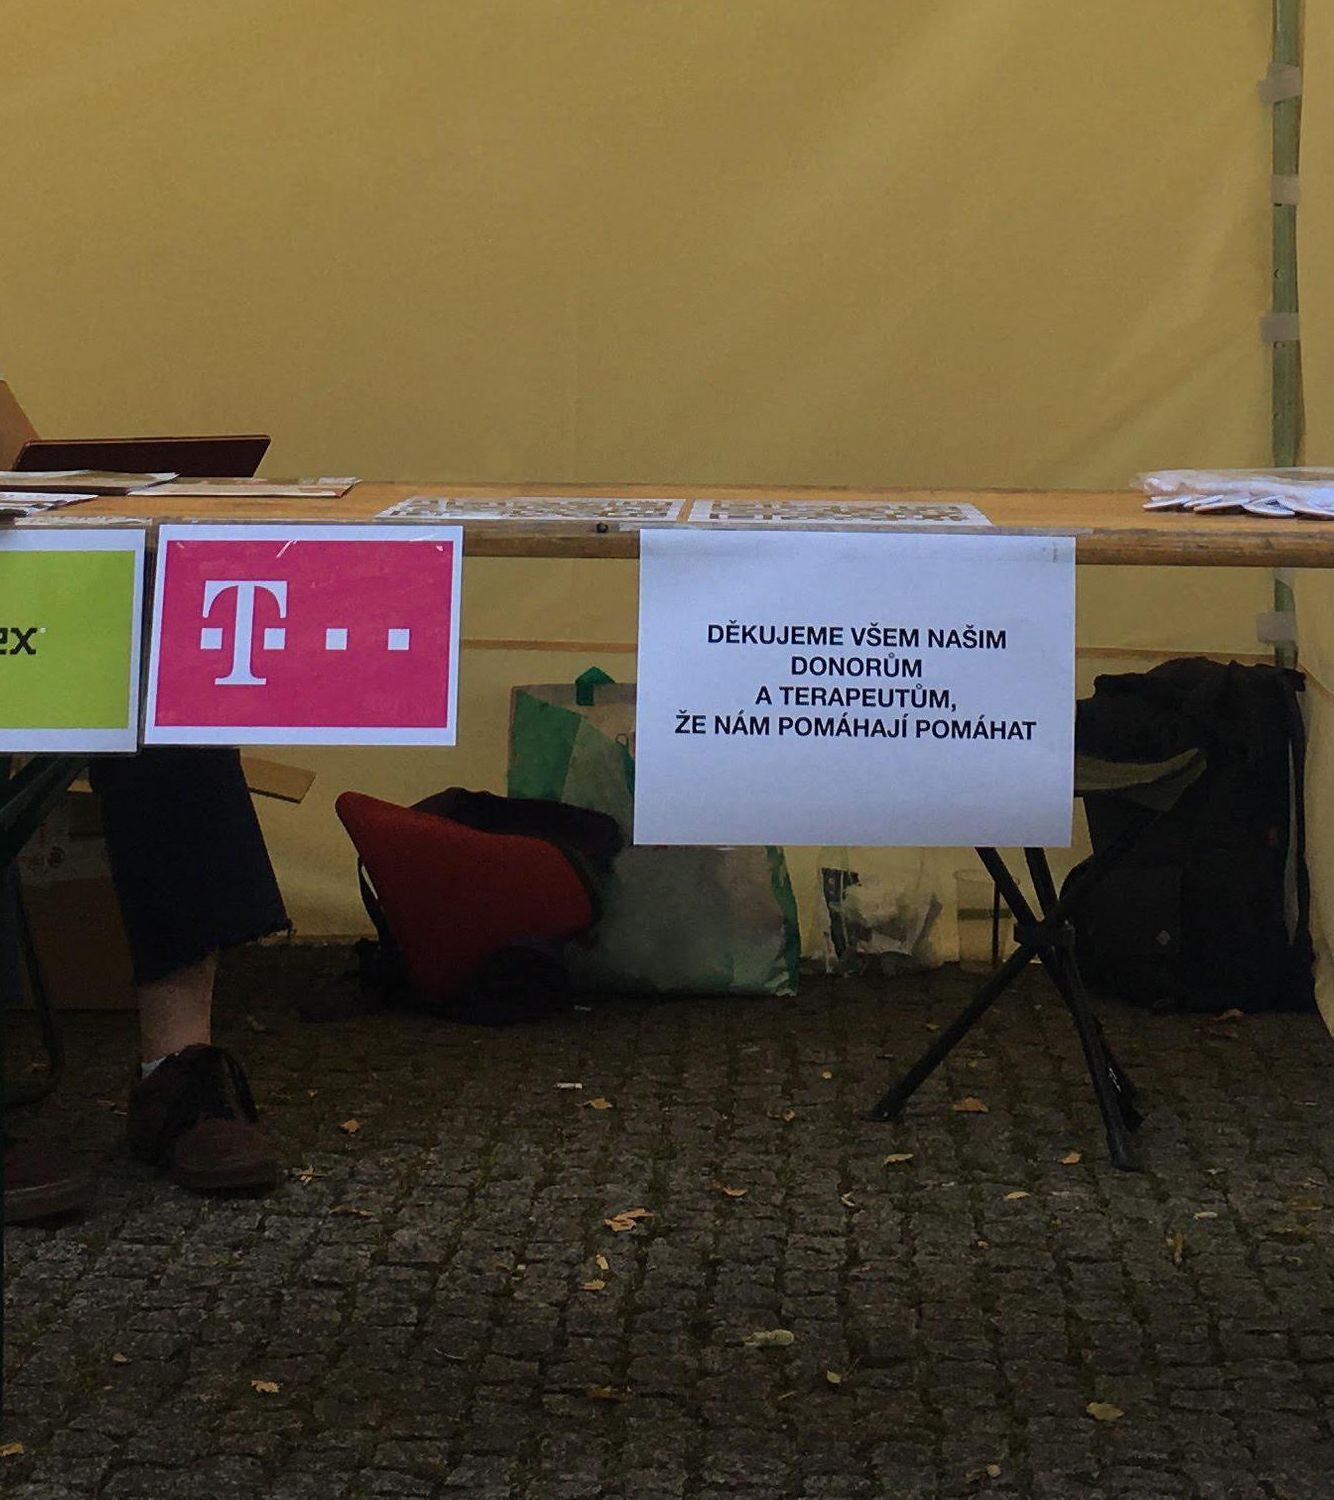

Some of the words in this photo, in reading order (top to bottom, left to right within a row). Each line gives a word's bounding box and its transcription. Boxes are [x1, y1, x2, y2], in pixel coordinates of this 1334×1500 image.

[202, 580, 289, 686] T
[707, 620, 844, 646] DĚKUJEME
[851, 621, 920, 648] VŠEM
[927, 623, 1007, 650] NAŠIM
[790, 652, 923, 679] DONORŮM
[755, 686, 774, 706] A
[779, 682, 957, 713] TERAPEUTŮM,
[675, 715, 707, 735] ŽE
[714, 710, 770, 736] NÁM
[778, 710, 908, 739] POMÁHAJÍ
[915, 713, 1037, 740] POMÁHAT
